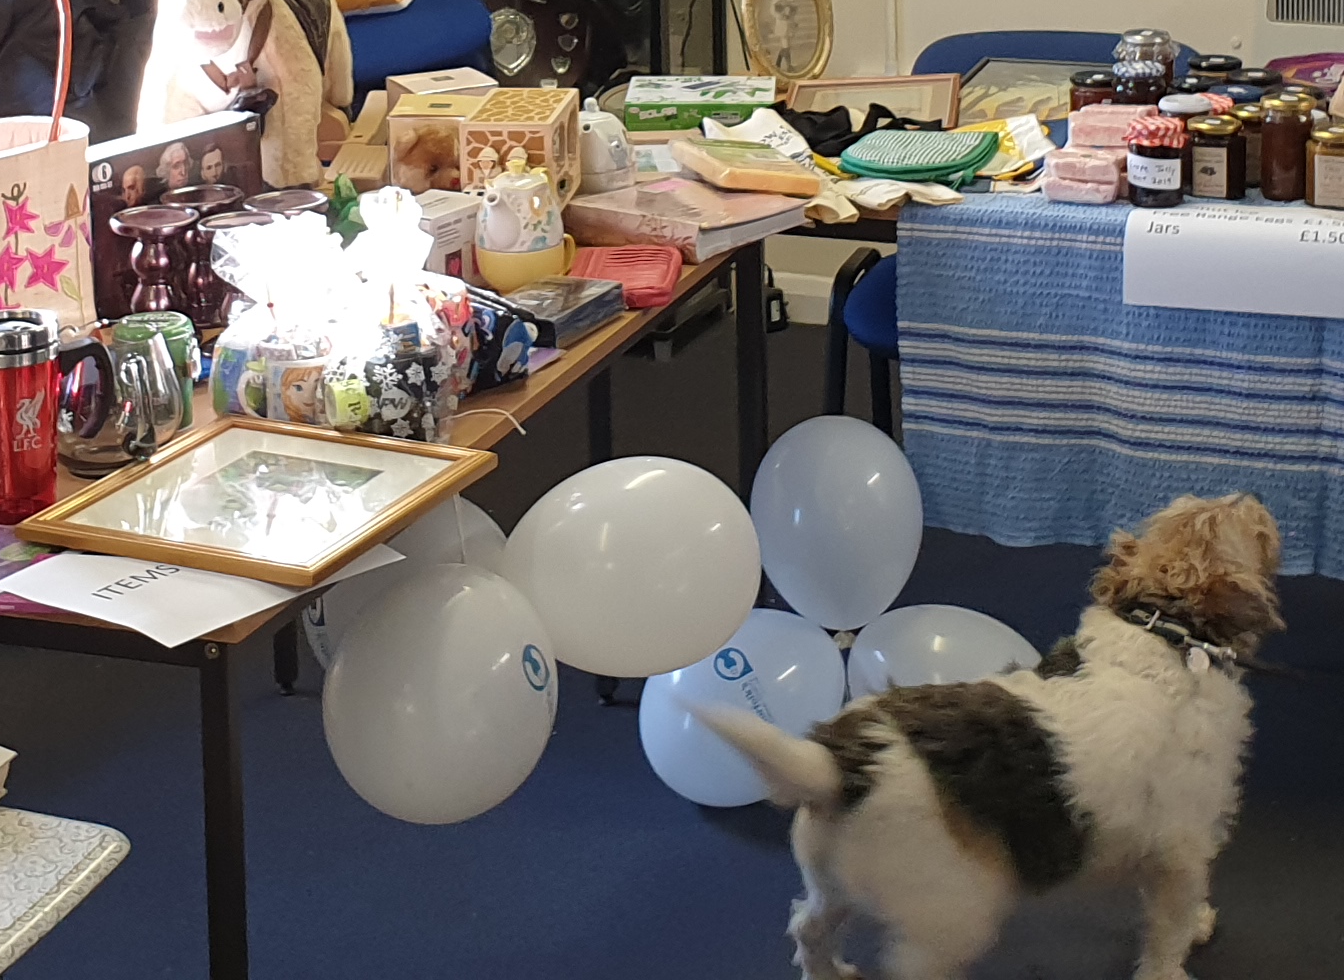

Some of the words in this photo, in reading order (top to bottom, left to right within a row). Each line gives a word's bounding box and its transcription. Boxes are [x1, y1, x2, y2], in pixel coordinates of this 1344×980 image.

[1195, 211, 1250, 222] Range
[1146, 220, 1181, 236] Jars
[90, 564, 181, 601] ITEMS
